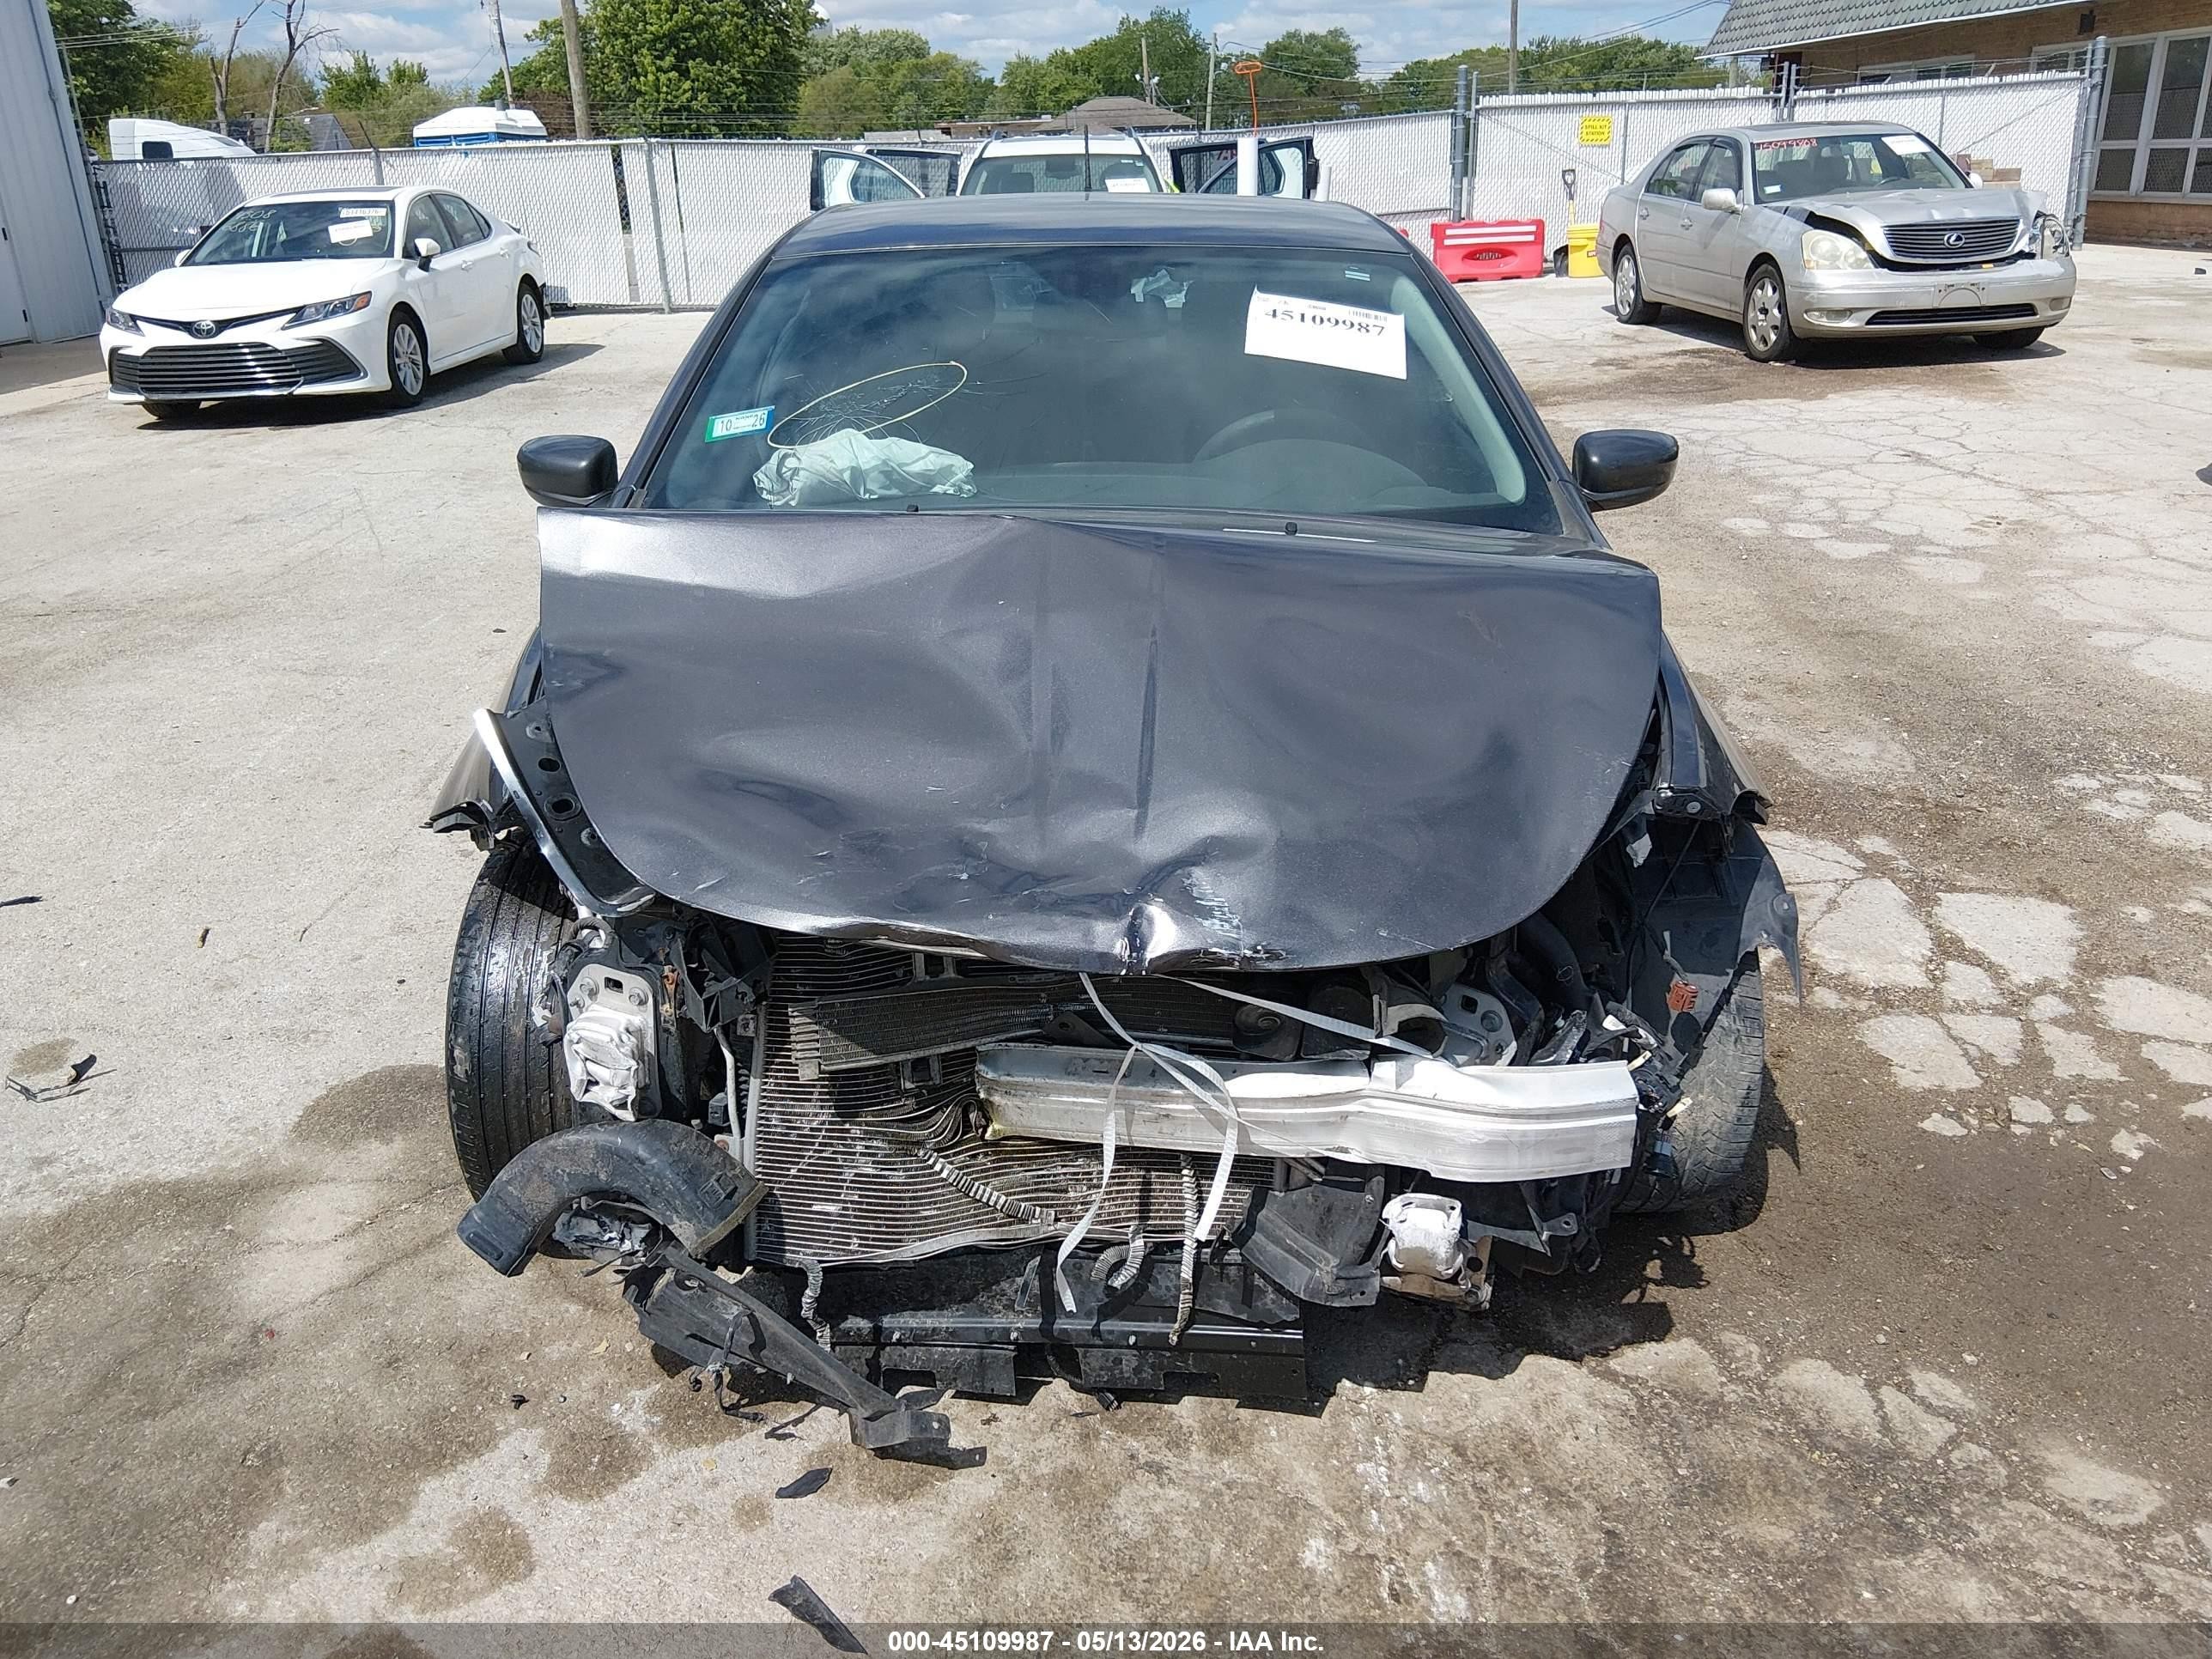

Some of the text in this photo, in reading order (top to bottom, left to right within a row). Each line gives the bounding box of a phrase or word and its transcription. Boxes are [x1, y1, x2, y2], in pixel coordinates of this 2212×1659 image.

[1265, 308, 1385, 336] 45109987
[720, 418, 732, 434] 10
[751, 412, 766, 428] 26
